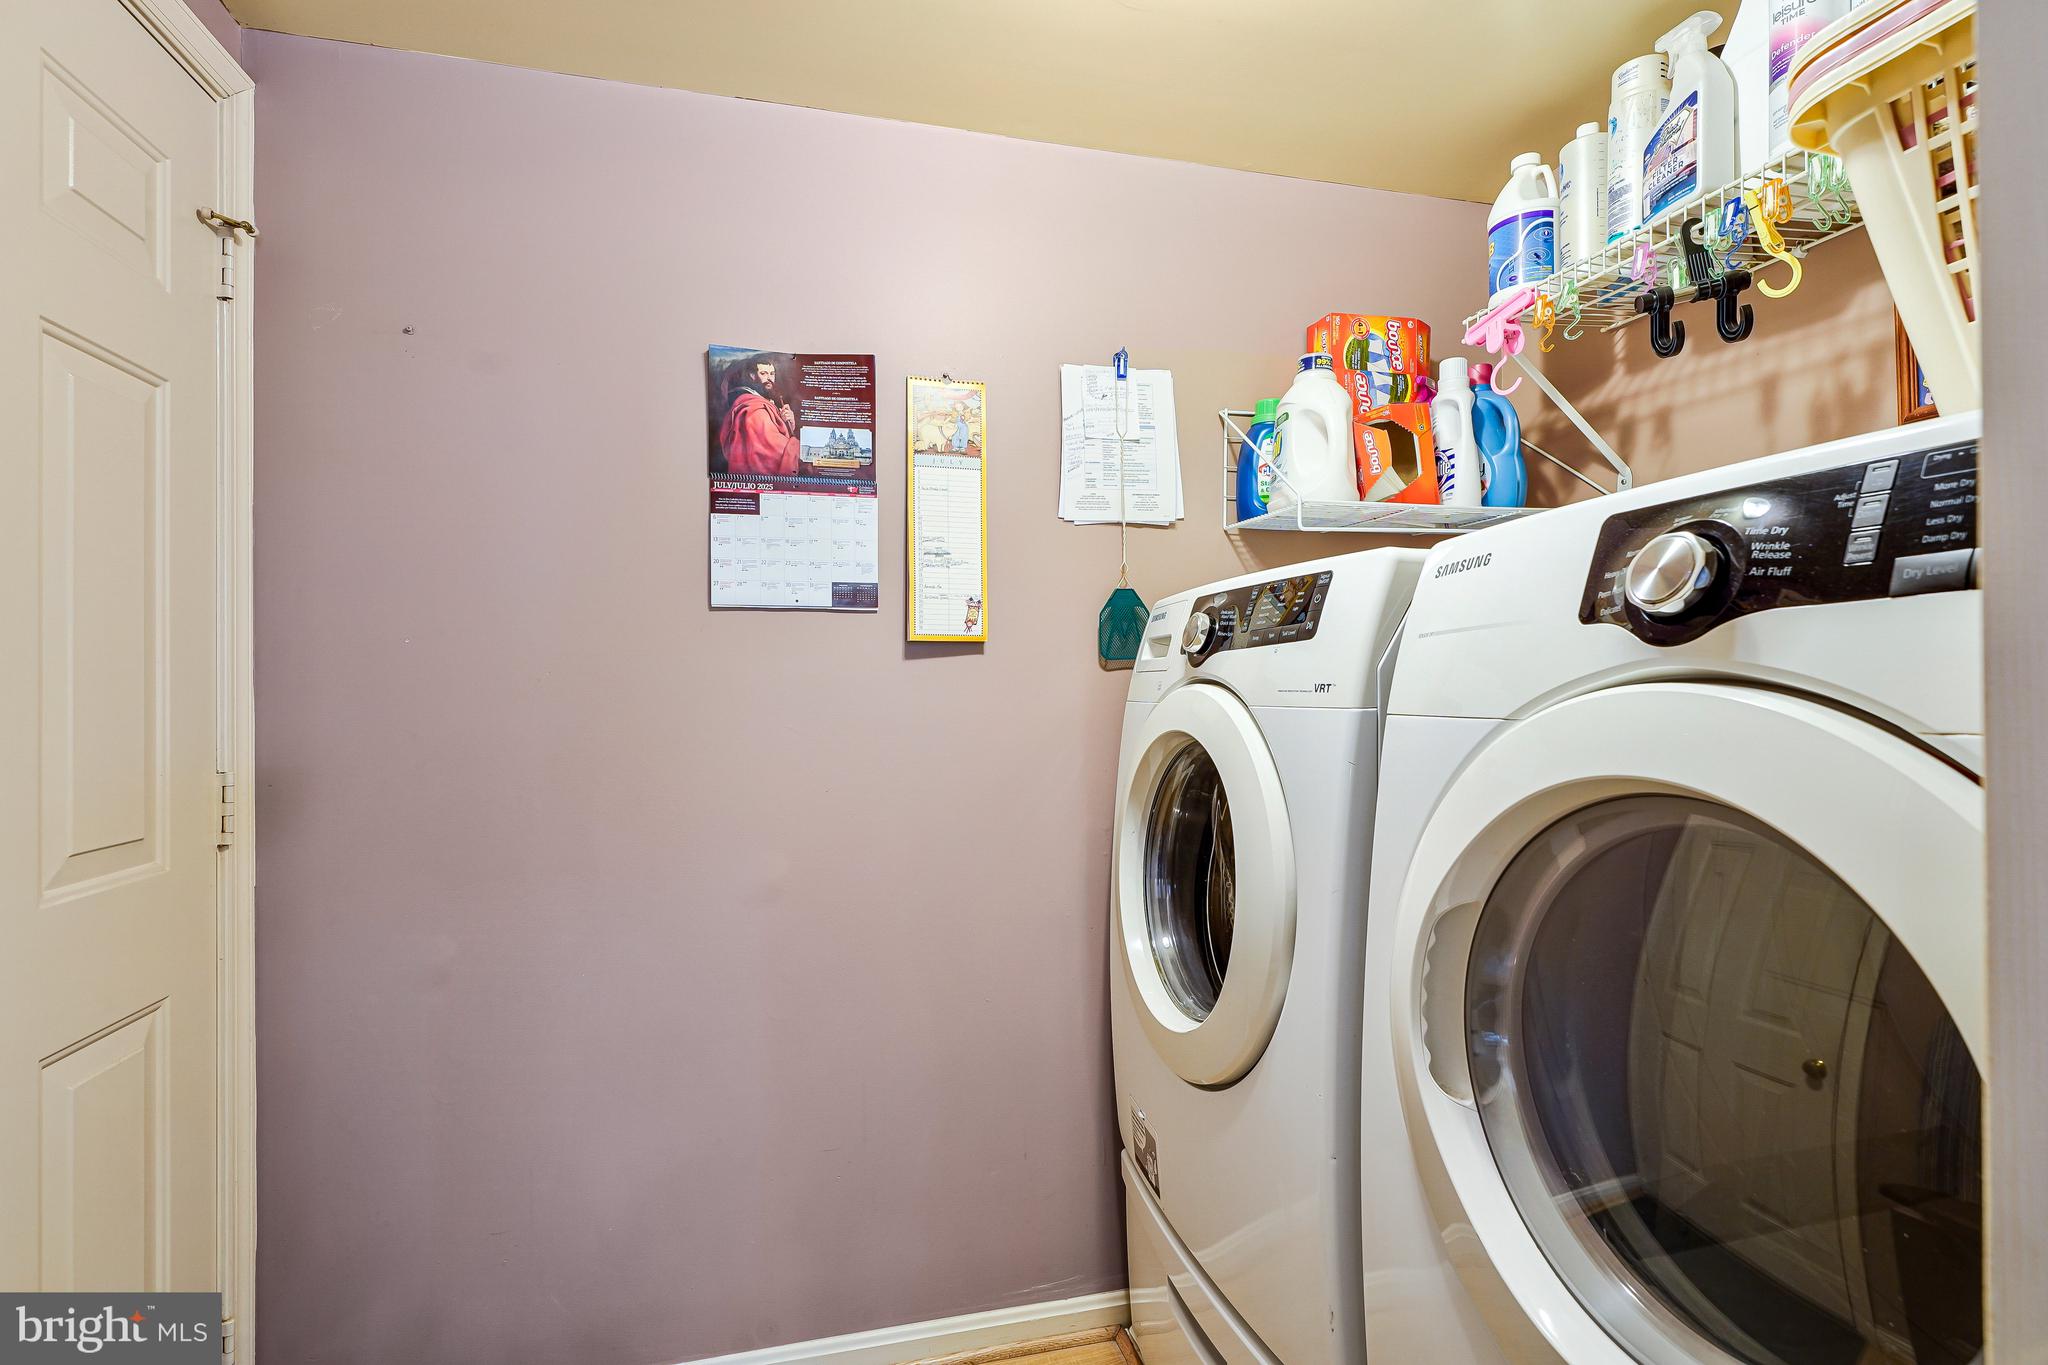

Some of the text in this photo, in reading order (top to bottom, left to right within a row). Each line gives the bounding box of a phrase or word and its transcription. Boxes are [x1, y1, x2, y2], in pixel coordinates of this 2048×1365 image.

[1780, 7, 1806, 25] TIME
[1652, 156, 1679, 180] FILTER
[1648, 161, 1684, 190] CLEANER
[1387, 319, 1404, 372] bounce
[1364, 431, 1382, 475] bounce
[712, 481, 757, 490] JULY/JULIO
[1837, 500, 1855, 508] Time
[1930, 496, 1963, 508] Normal
[1926, 514, 1964, 526] Less Dry
[1745, 526, 1789, 537] Time Dry
[1921, 531, 1967, 544] Damp Dry
[1751, 541, 1791, 551] Wrinkle
[1751, 550, 1792, 560] Release
[1435, 552, 1493, 579] SAMSUNG
[1748, 566, 1793, 576] Air Fluff
[1903, 563, 1959, 580] Dry Level
[1314, 683, 1332, 693] VRT
